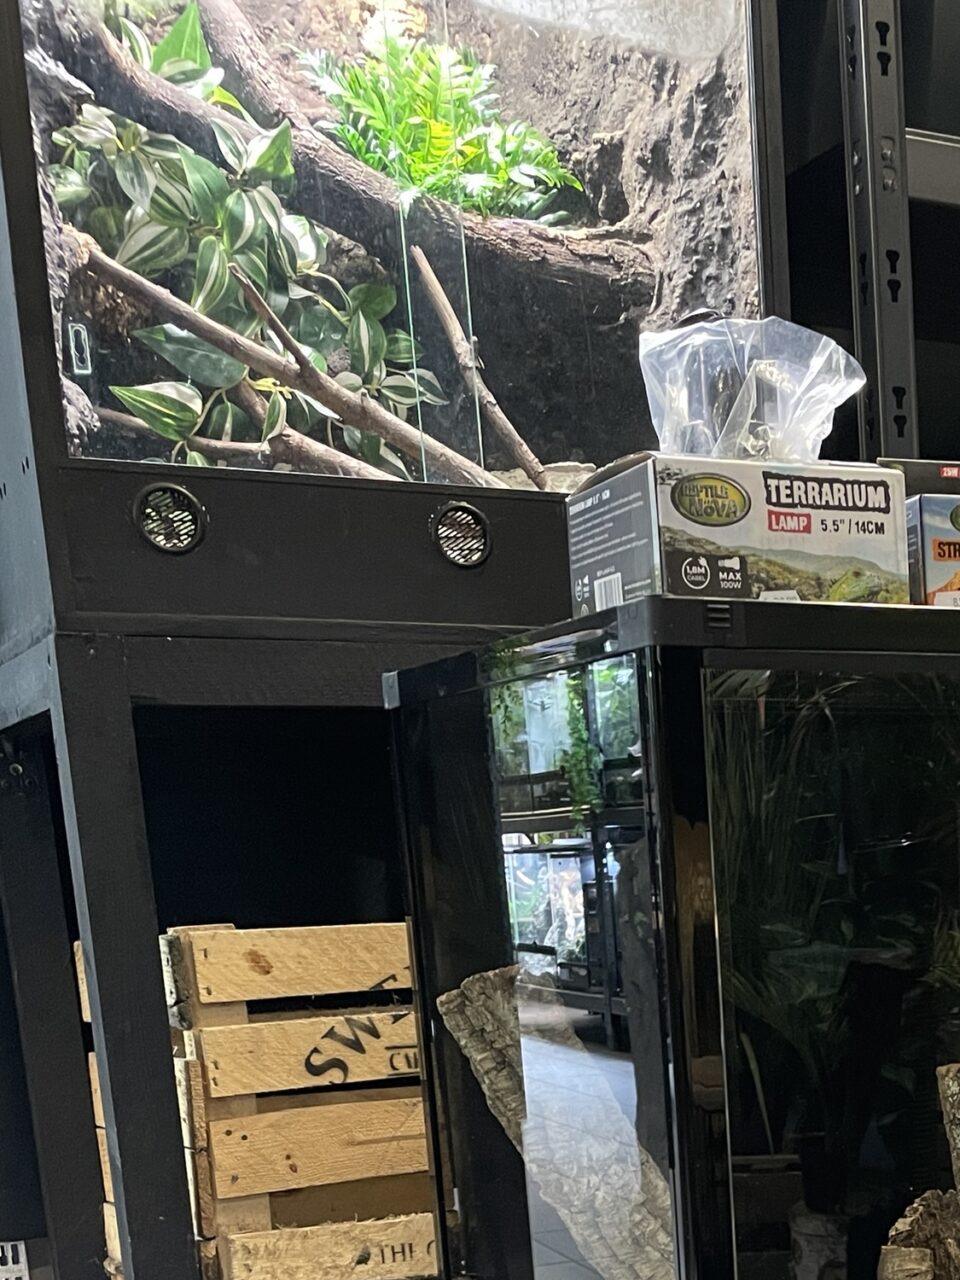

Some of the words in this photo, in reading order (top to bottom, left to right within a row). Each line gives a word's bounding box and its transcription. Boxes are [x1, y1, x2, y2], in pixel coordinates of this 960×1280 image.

[766, 478, 887, 509] TERRARIUM
[771, 514, 808, 531] LAMP
[719, 572, 742, 581] MAX
[720, 580, 742, 589] 100W
